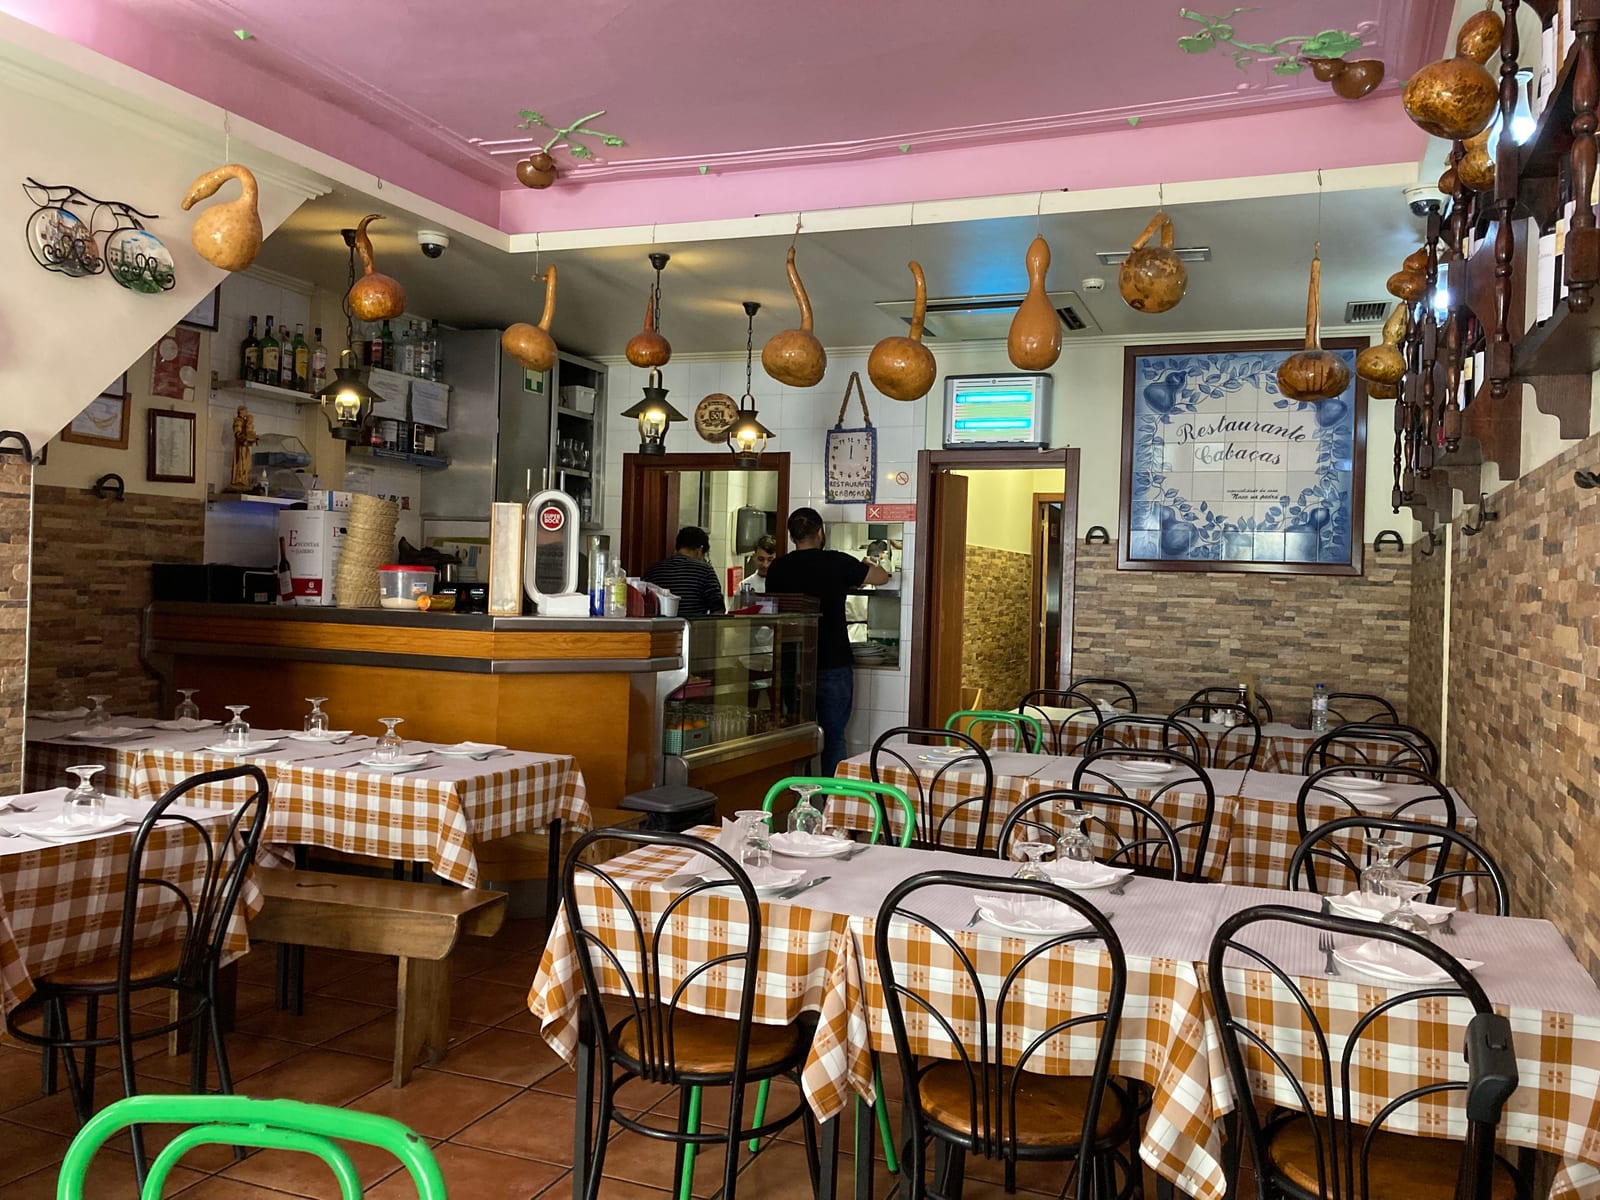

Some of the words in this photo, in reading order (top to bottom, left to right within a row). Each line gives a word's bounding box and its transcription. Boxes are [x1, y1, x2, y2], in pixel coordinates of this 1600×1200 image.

[1176, 415, 1306, 445] Restaurante
[1195, 443, 1281, 465] Cabaças
[834, 490, 865, 498] CABAÇAS
